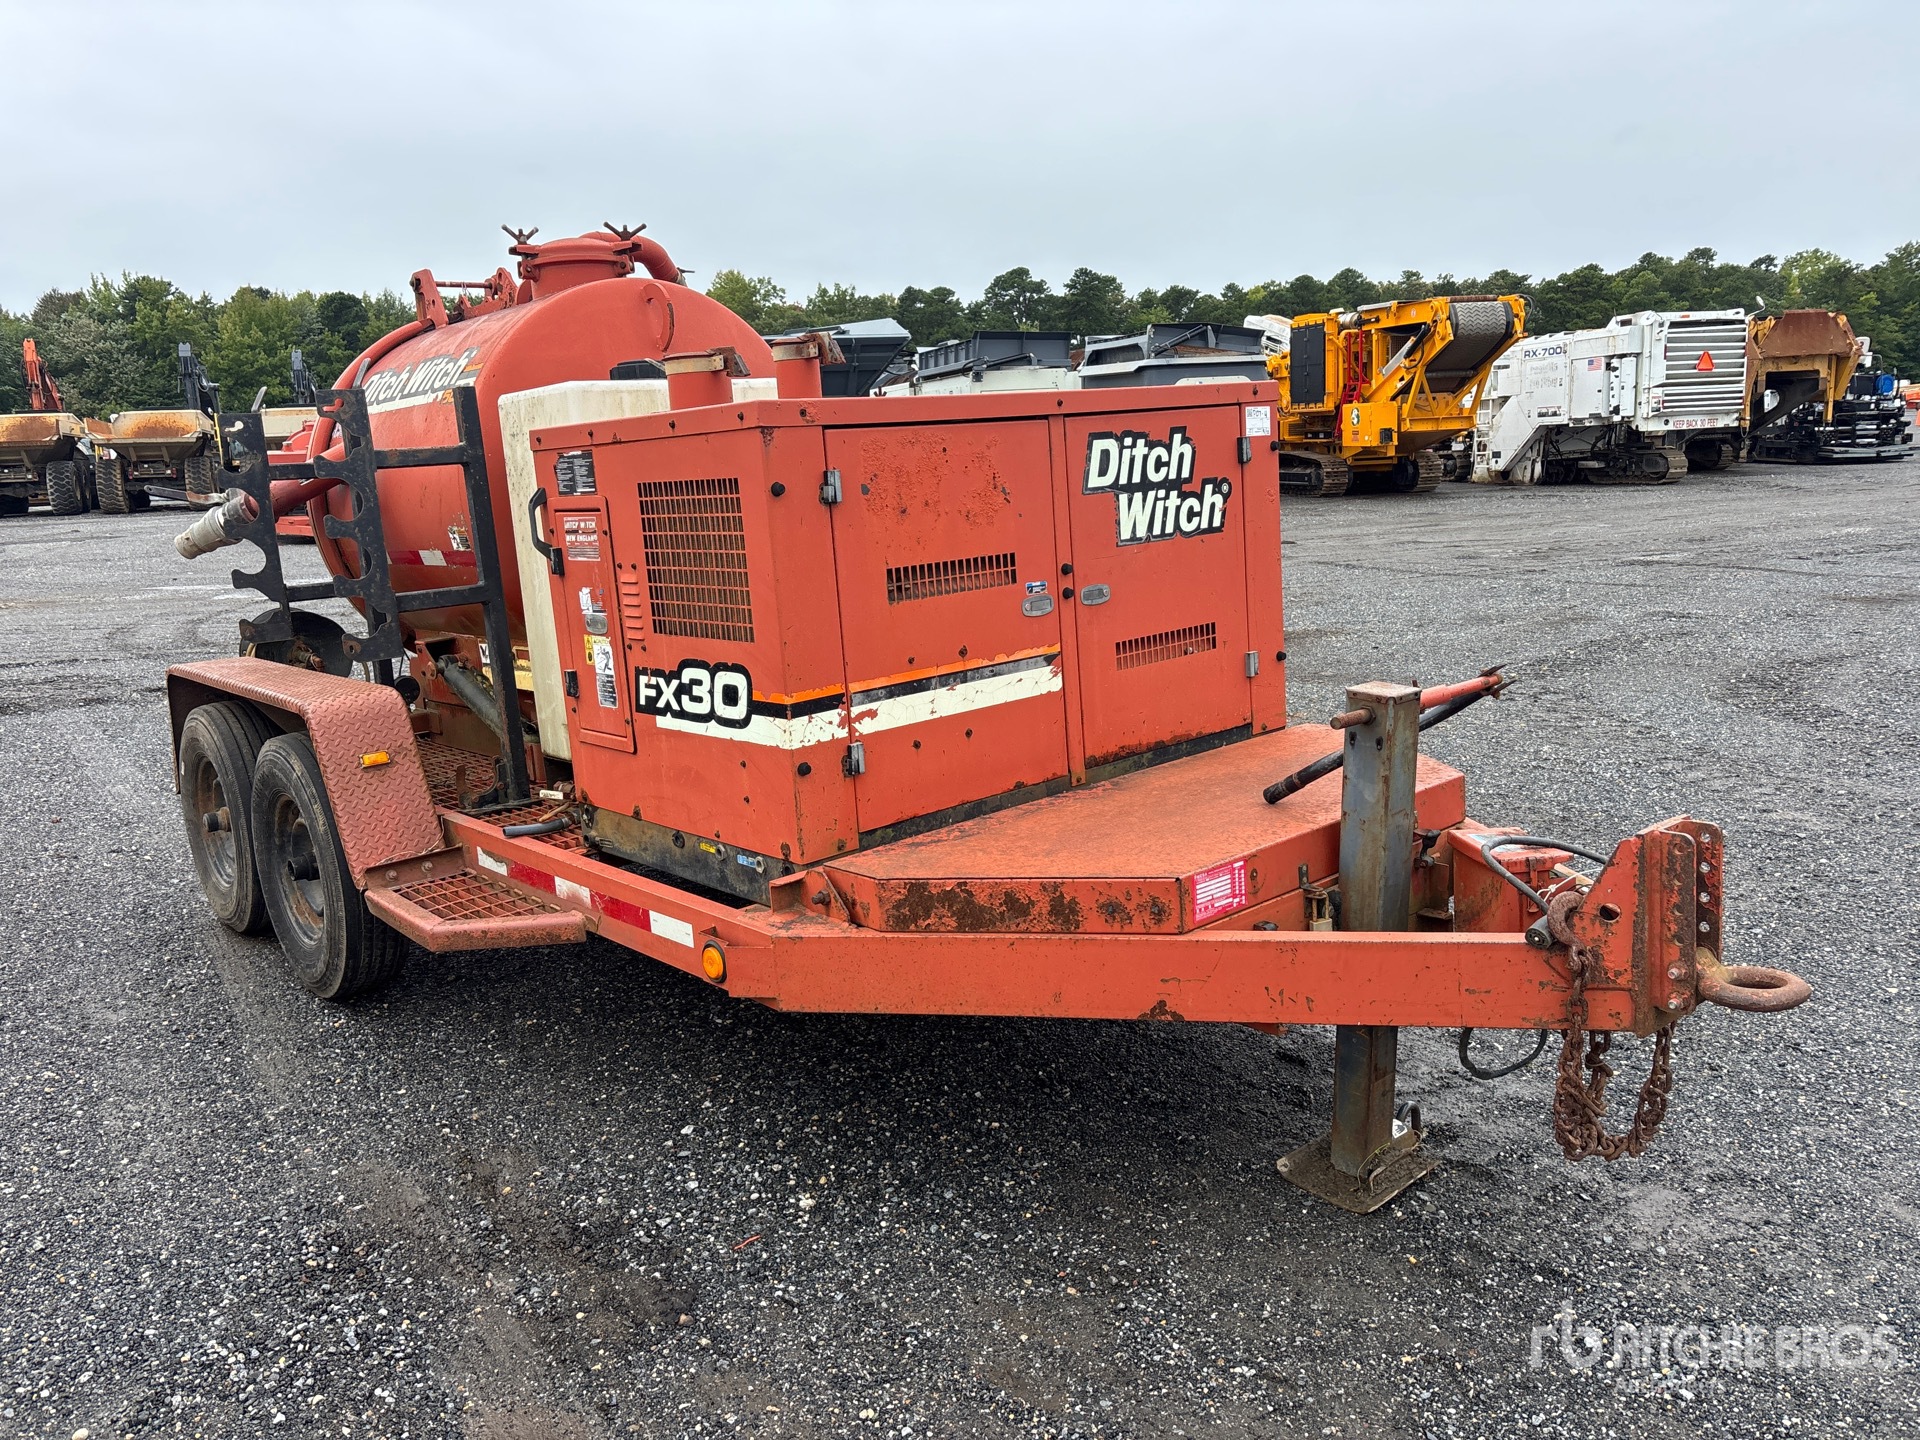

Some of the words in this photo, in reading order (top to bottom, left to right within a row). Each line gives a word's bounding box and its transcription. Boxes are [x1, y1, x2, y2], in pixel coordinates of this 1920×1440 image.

[1672, 419, 1685, 429] KEEP
[1686, 418, 1699, 428] BACK
[1707, 417, 1719, 427] FEET
[1087, 433, 1193, 488] Ditch
[639, 667, 748, 720] FX30
